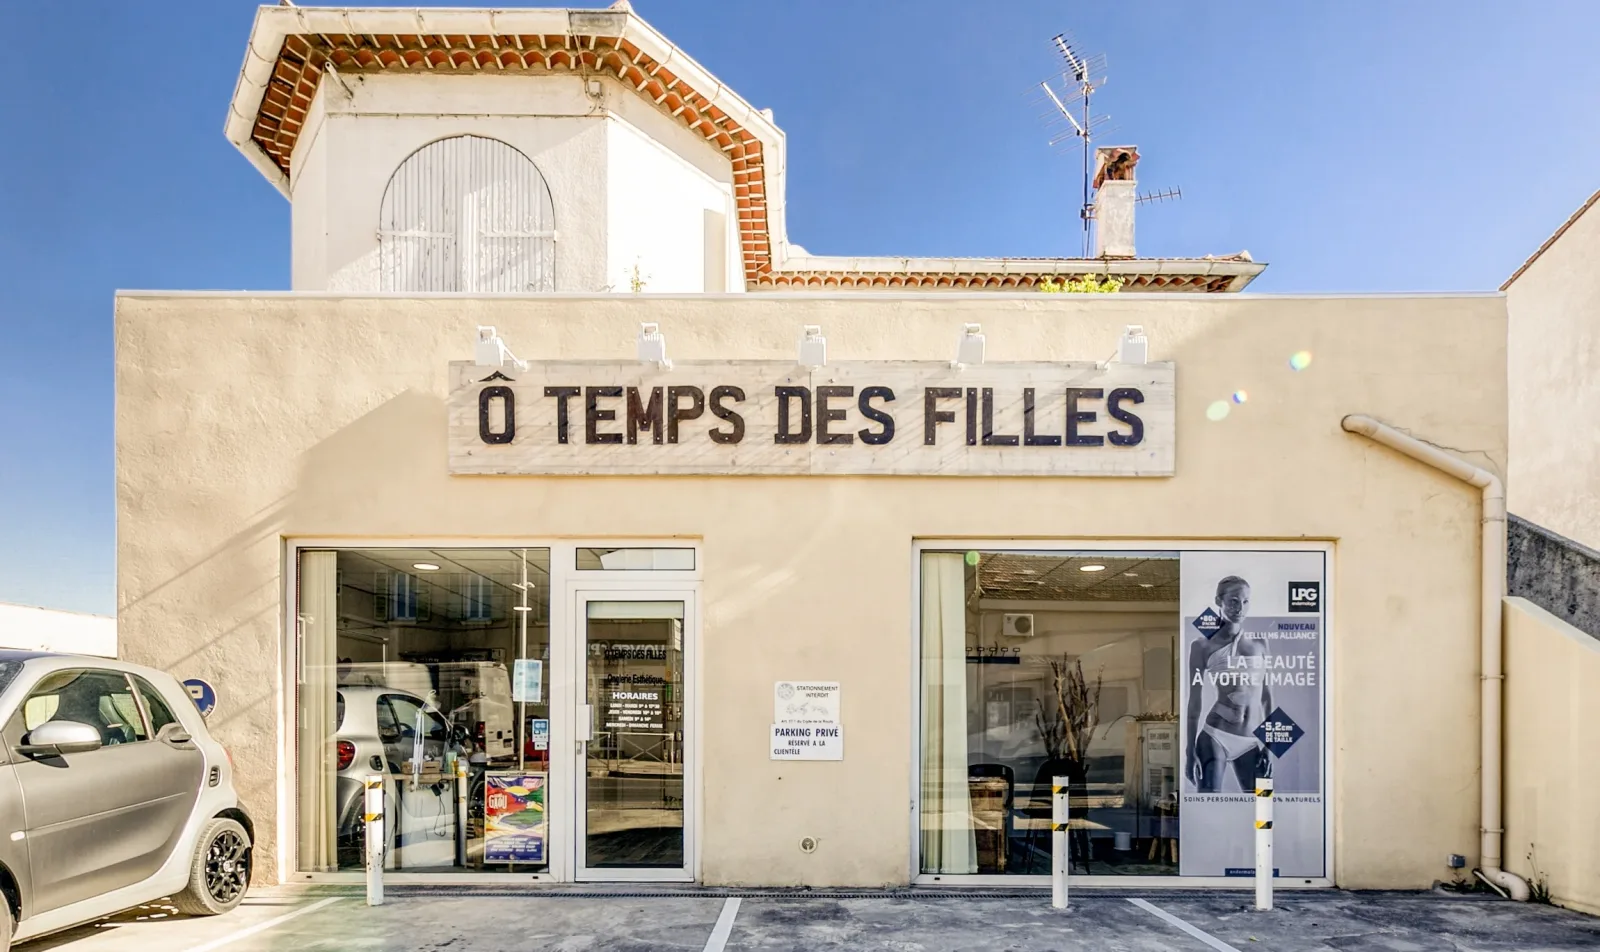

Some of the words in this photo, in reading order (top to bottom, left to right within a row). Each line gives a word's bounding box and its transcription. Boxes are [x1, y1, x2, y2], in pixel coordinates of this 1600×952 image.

[478, 371, 516, 445] Ô
[544, 386, 746, 446] TEMPS
[774, 386, 896, 446] DES
[925, 386, 1145, 447] FILLES
[1292, 588, 1318, 601] LPG
[1278, 623, 1316, 631] NOUVEAU
[633, 650, 645, 659] DES
[646, 650, 667, 660] FILLES
[1227, 655, 1248, 669] LA
[1255, 651, 1316, 669] BEAUTÉ
[1192, 667, 1203, 686] À
[1208, 672, 1260, 686] VOTRE
[1265, 672, 1316, 686] IMAGE
[612, 692, 659, 701] HORAIRES
[775, 728, 811, 737] PARKING
[816, 725, 839, 738] PRIVÉ
